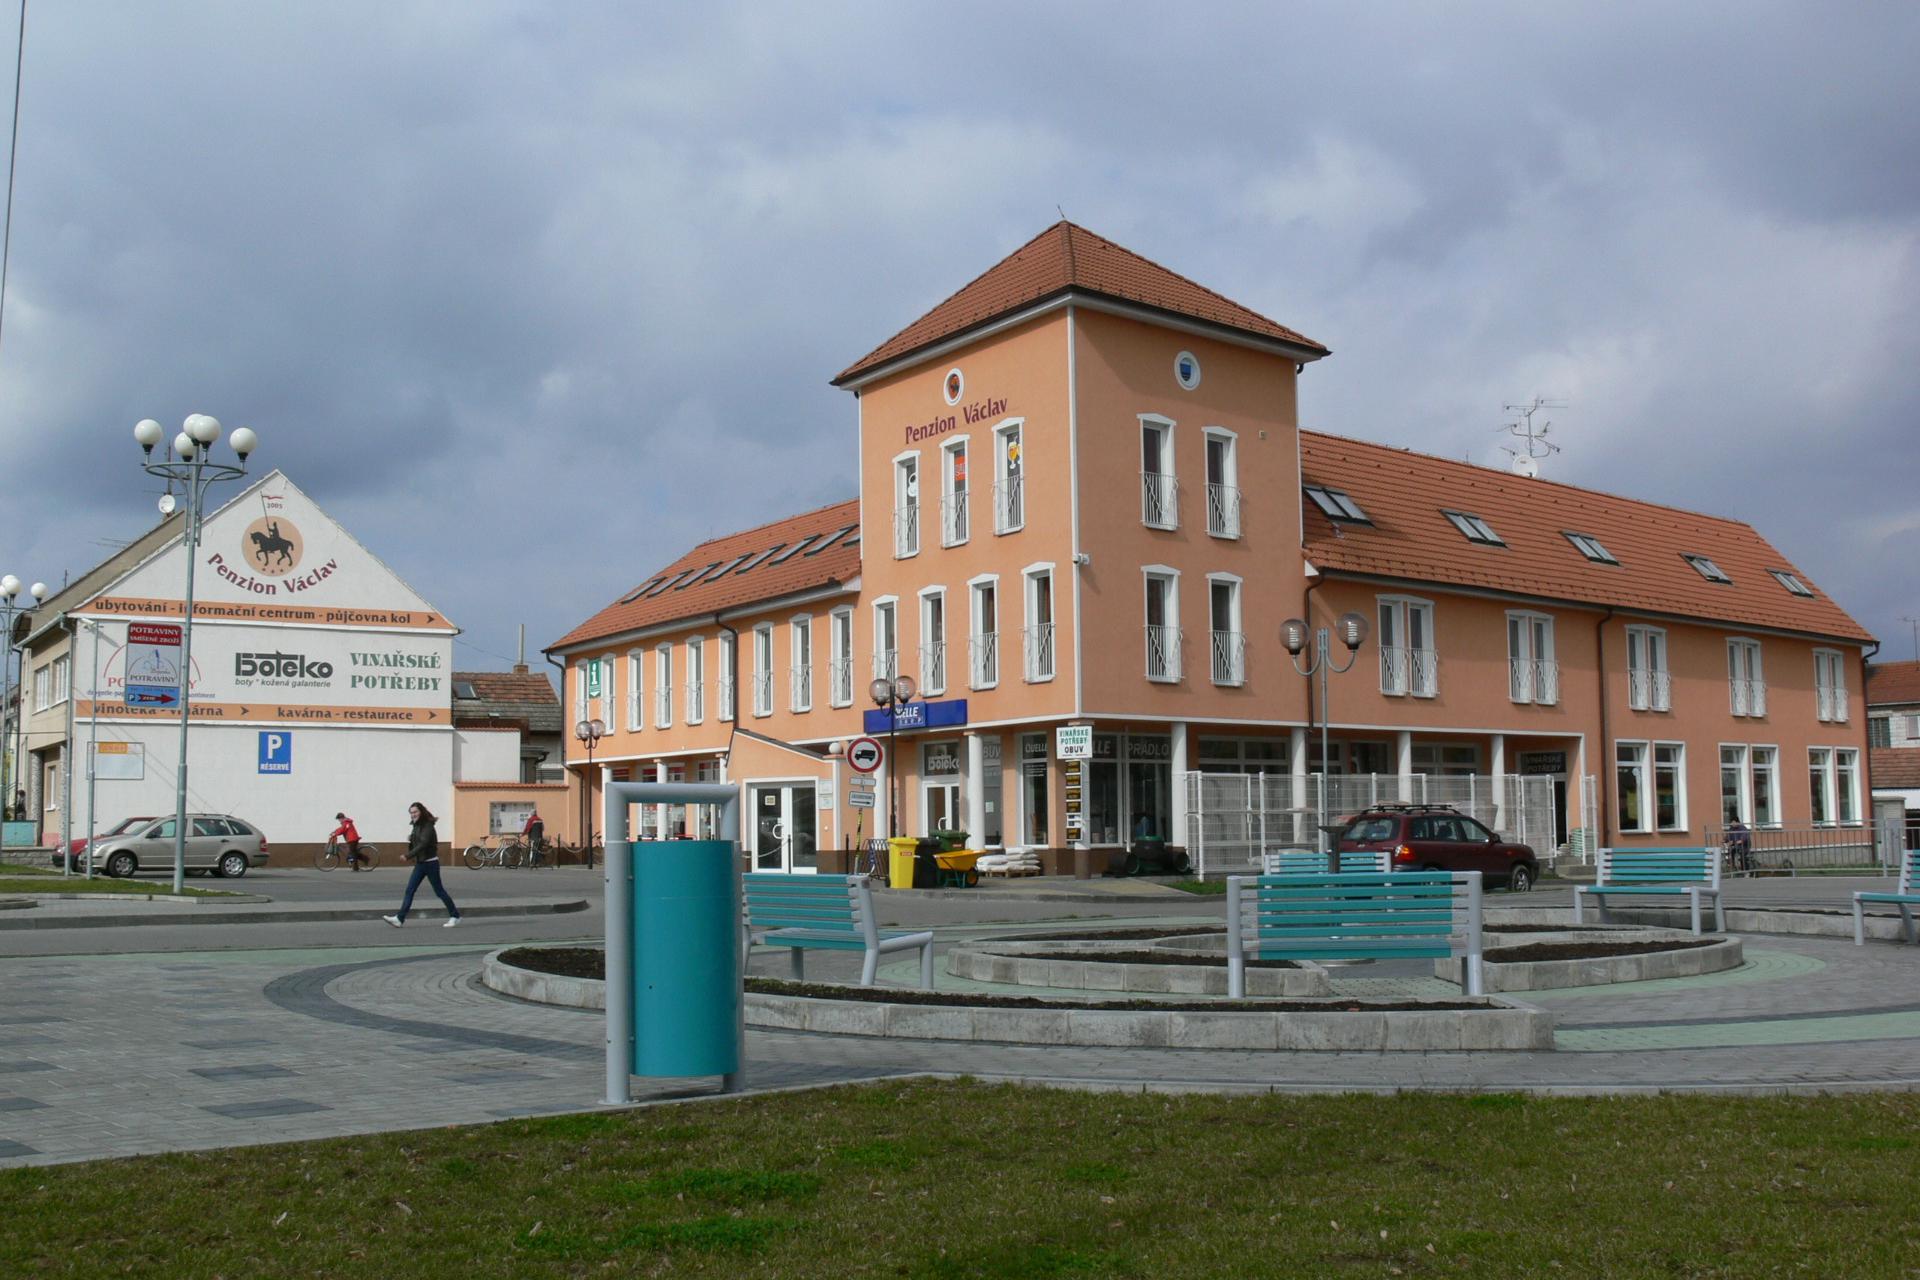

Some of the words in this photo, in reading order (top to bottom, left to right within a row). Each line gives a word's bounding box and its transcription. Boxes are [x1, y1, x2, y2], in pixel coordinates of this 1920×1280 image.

[905, 416, 956, 444] Penzion
[963, 398, 1008, 424] Václav
[207, 553, 276, 595] Penzion
[283, 558, 338, 593] Václav
[95, 599, 167, 613] ubytování
[259, 608, 315, 620] centrum
[326, 609, 387, 624] půjčovna
[390, 611, 410, 623] kol
[130, 626, 179, 636] POTRAVINY
[350, 650, 441, 669] VINAŘSKÉ
[130, 674, 176, 683] POTRAVINY
[235, 678, 254, 687] boty
[261, 677, 290, 687] kožená
[291, 679, 331, 688] galanterie
[350, 672, 442, 691] POTŘEBY
[169, 704, 224, 716] viárna
[277, 706, 332, 719] kavárna
[344, 711, 413, 720] restaurace
[267, 734, 282, 760] P
[1064, 745, 1084, 754] OBUV
[260, 762, 290, 772] RÉSERVÉ
